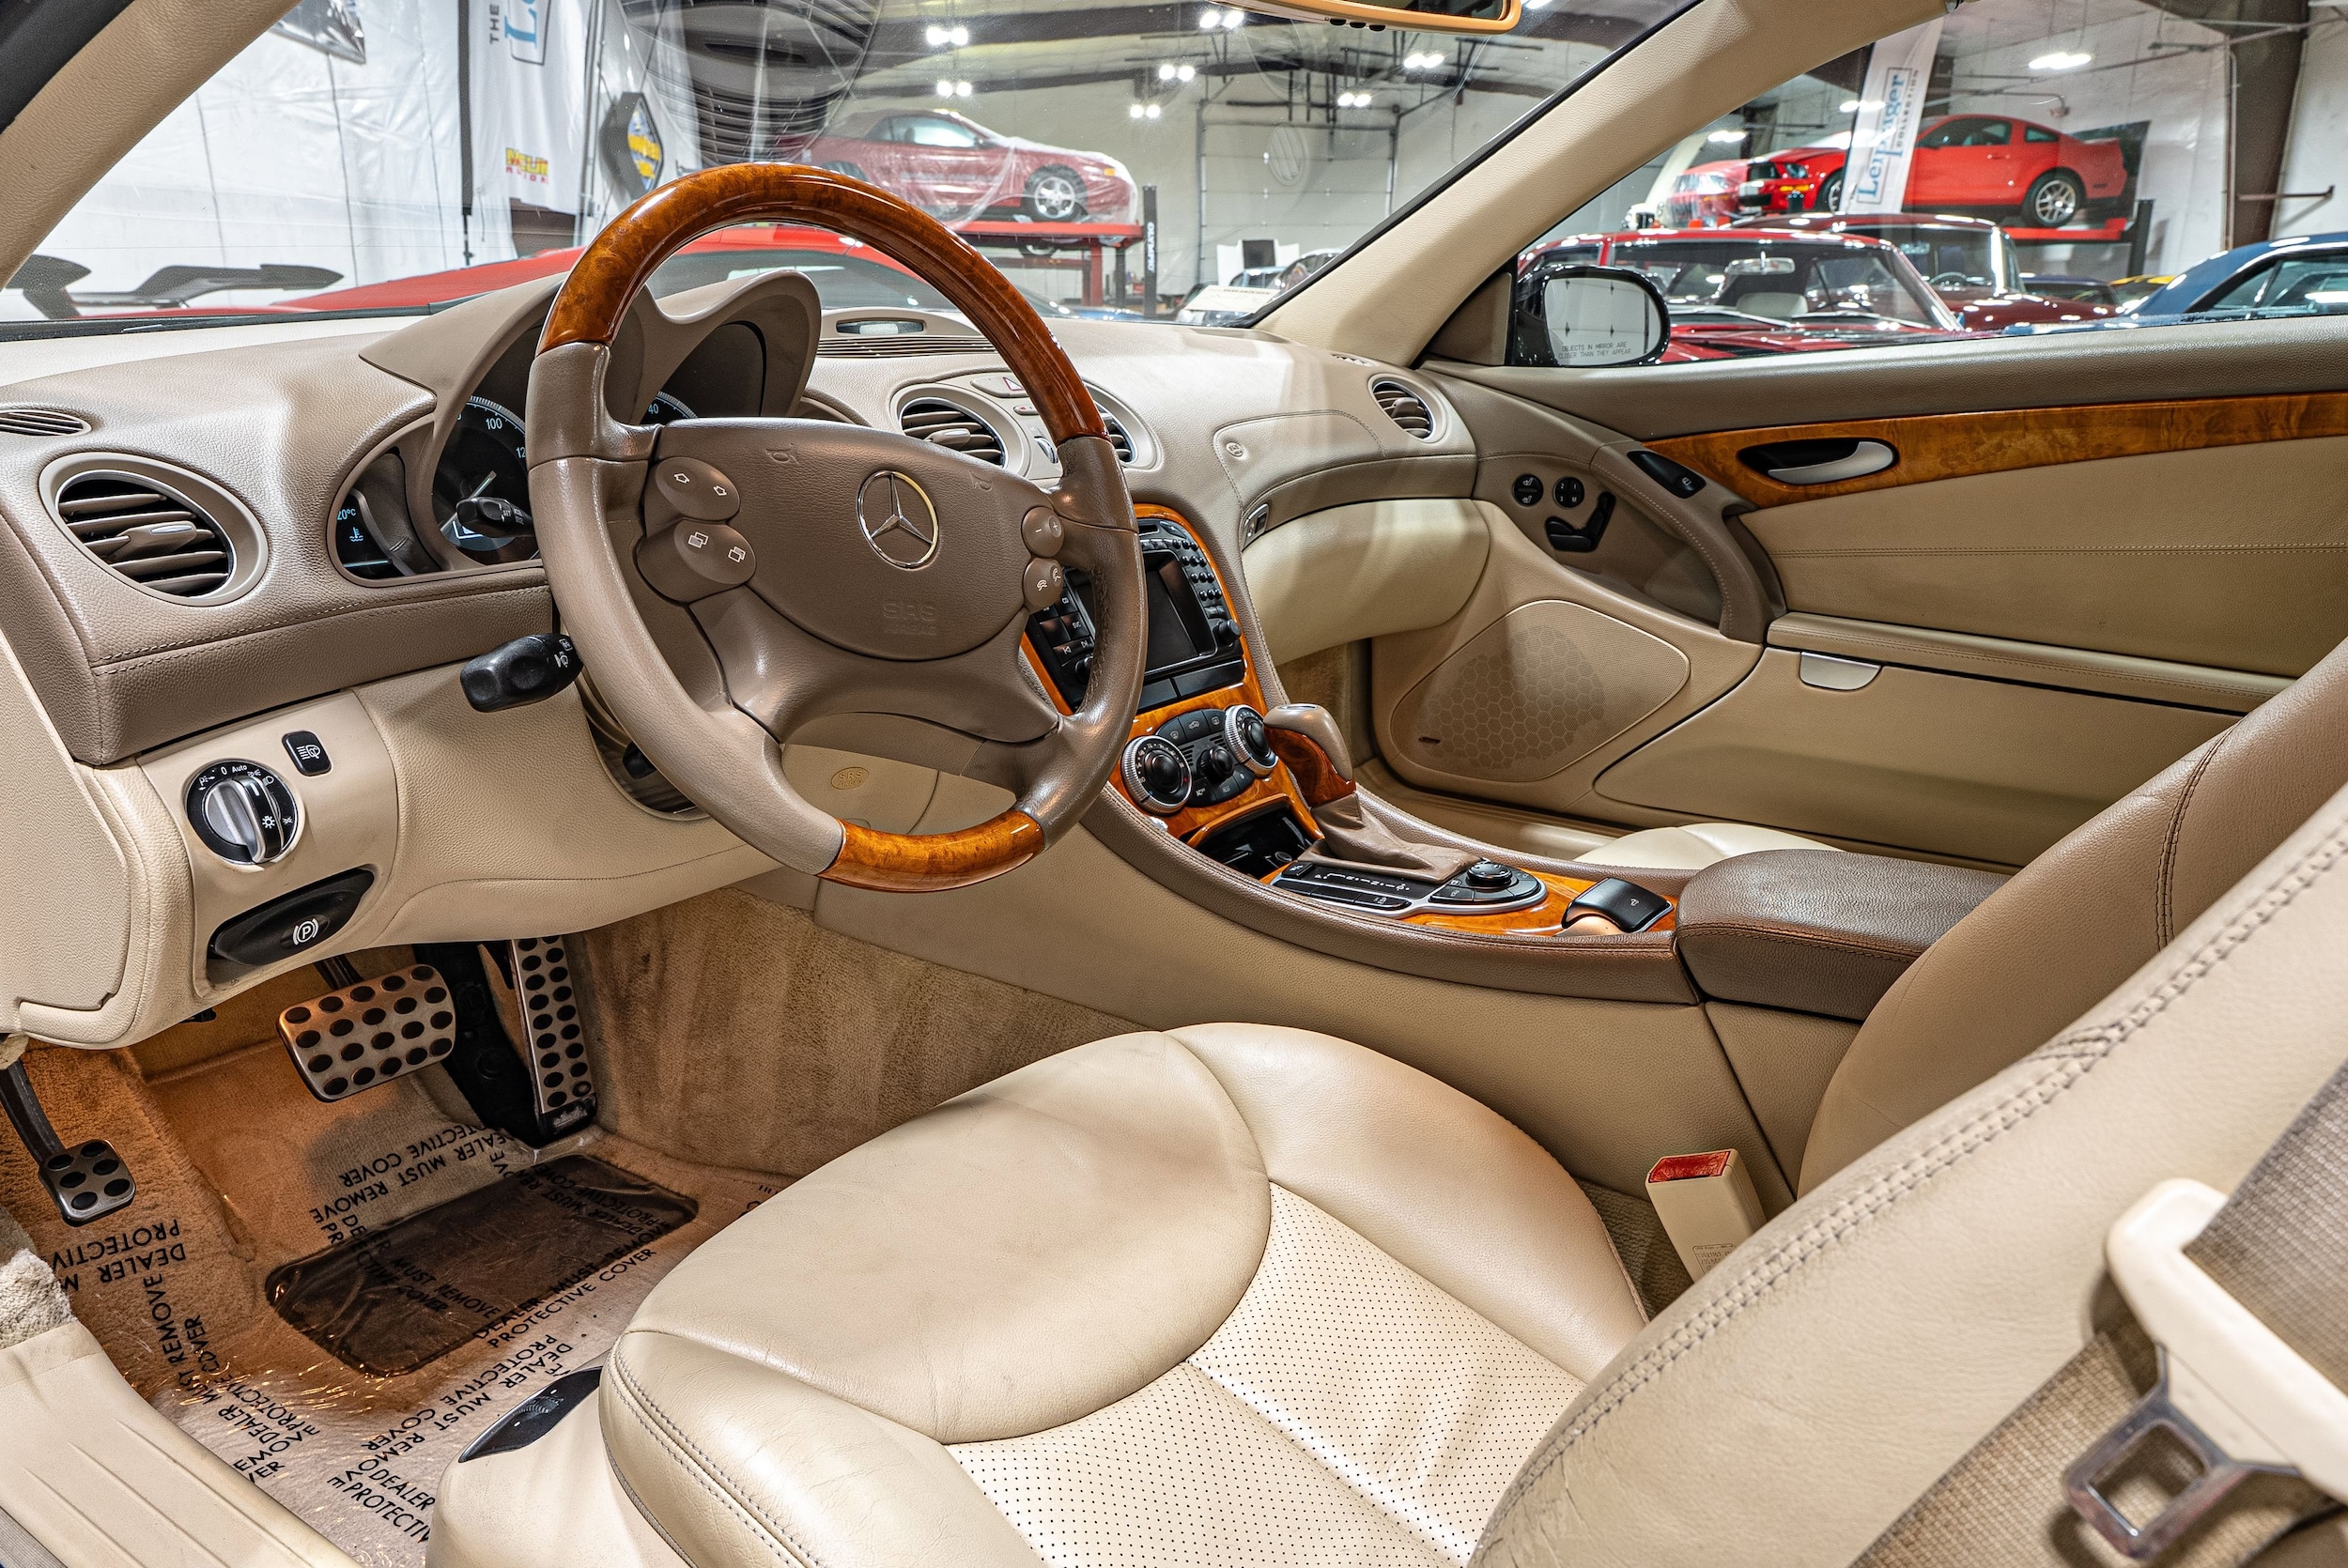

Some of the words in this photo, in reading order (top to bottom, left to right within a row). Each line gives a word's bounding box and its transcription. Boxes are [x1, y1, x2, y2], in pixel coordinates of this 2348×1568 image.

[489, 4, 500, 45] THE
[486, 418, 502, 430] 100
[232, 764, 248, 774] Auto
[839, 770, 863, 780] SRS
[454, 1130, 508, 1161] EALER
[338, 1152, 402, 1188] COVER
[398, 1154, 446, 1188] MUST
[309, 1180, 389, 1224] REMOVE
[540, 1190, 587, 1211] MUST
[97, 1243, 186, 1284] DEALER
[390, 1257, 437, 1284] MUST
[434, 1284, 502, 1318] REMOVE
[472, 1297, 545, 1339] DEALER
[550, 1262, 600, 1295] MUST
[487, 1283, 596, 1348] PROTECTIVE
[599, 1249, 657, 1282] COVER
[143, 1273, 188, 1364] REMOVE
[184, 1314, 220, 1373] COVER
[440, 1334, 557, 1407] PROTECTIVE
[499, 1343, 573, 1390] DEALER
[218, 1405, 280, 1444] DEALER
[361, 1408, 436, 1451] COVER
[433, 1391, 492, 1431] MUST
[327, 1432, 425, 1489] REMOVE
[368, 1468, 436, 1511] DEALER
